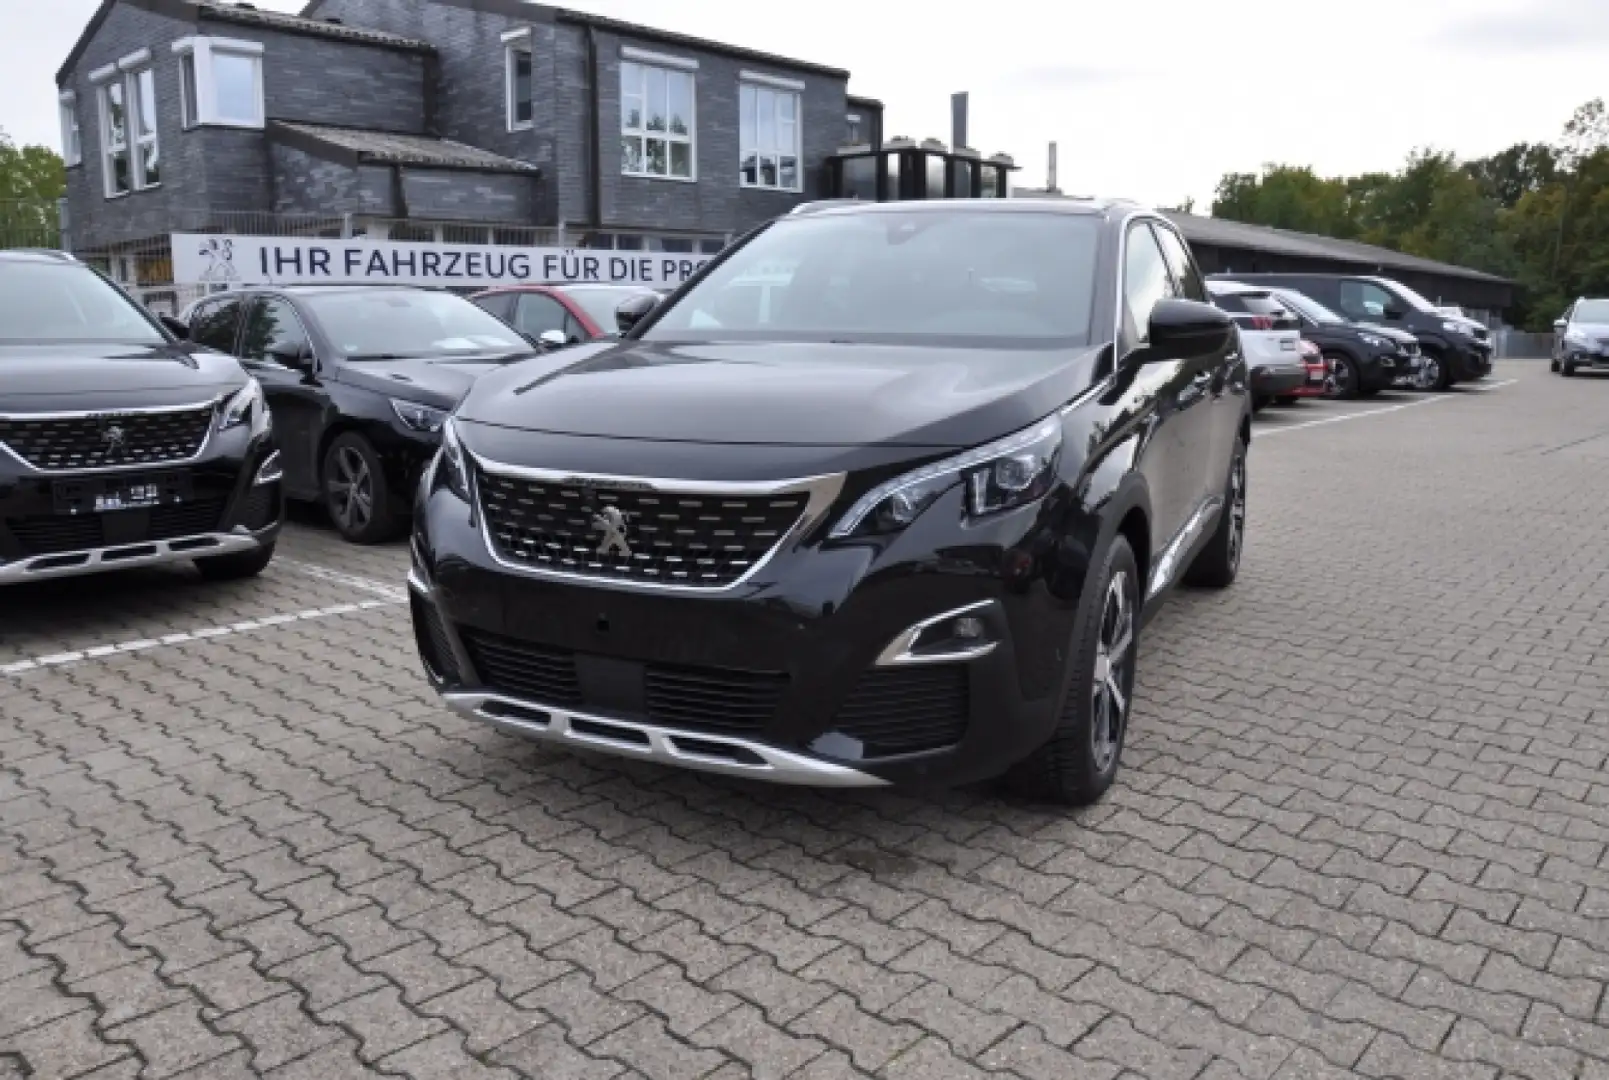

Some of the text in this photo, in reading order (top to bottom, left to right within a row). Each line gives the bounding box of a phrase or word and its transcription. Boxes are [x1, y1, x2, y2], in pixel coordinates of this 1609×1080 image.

[260, 246, 331, 276] IHR
[344, 249, 531, 279] FAHRZEUG
[543, 250, 600, 280] FÜR
[609, 256, 653, 282] DIE
